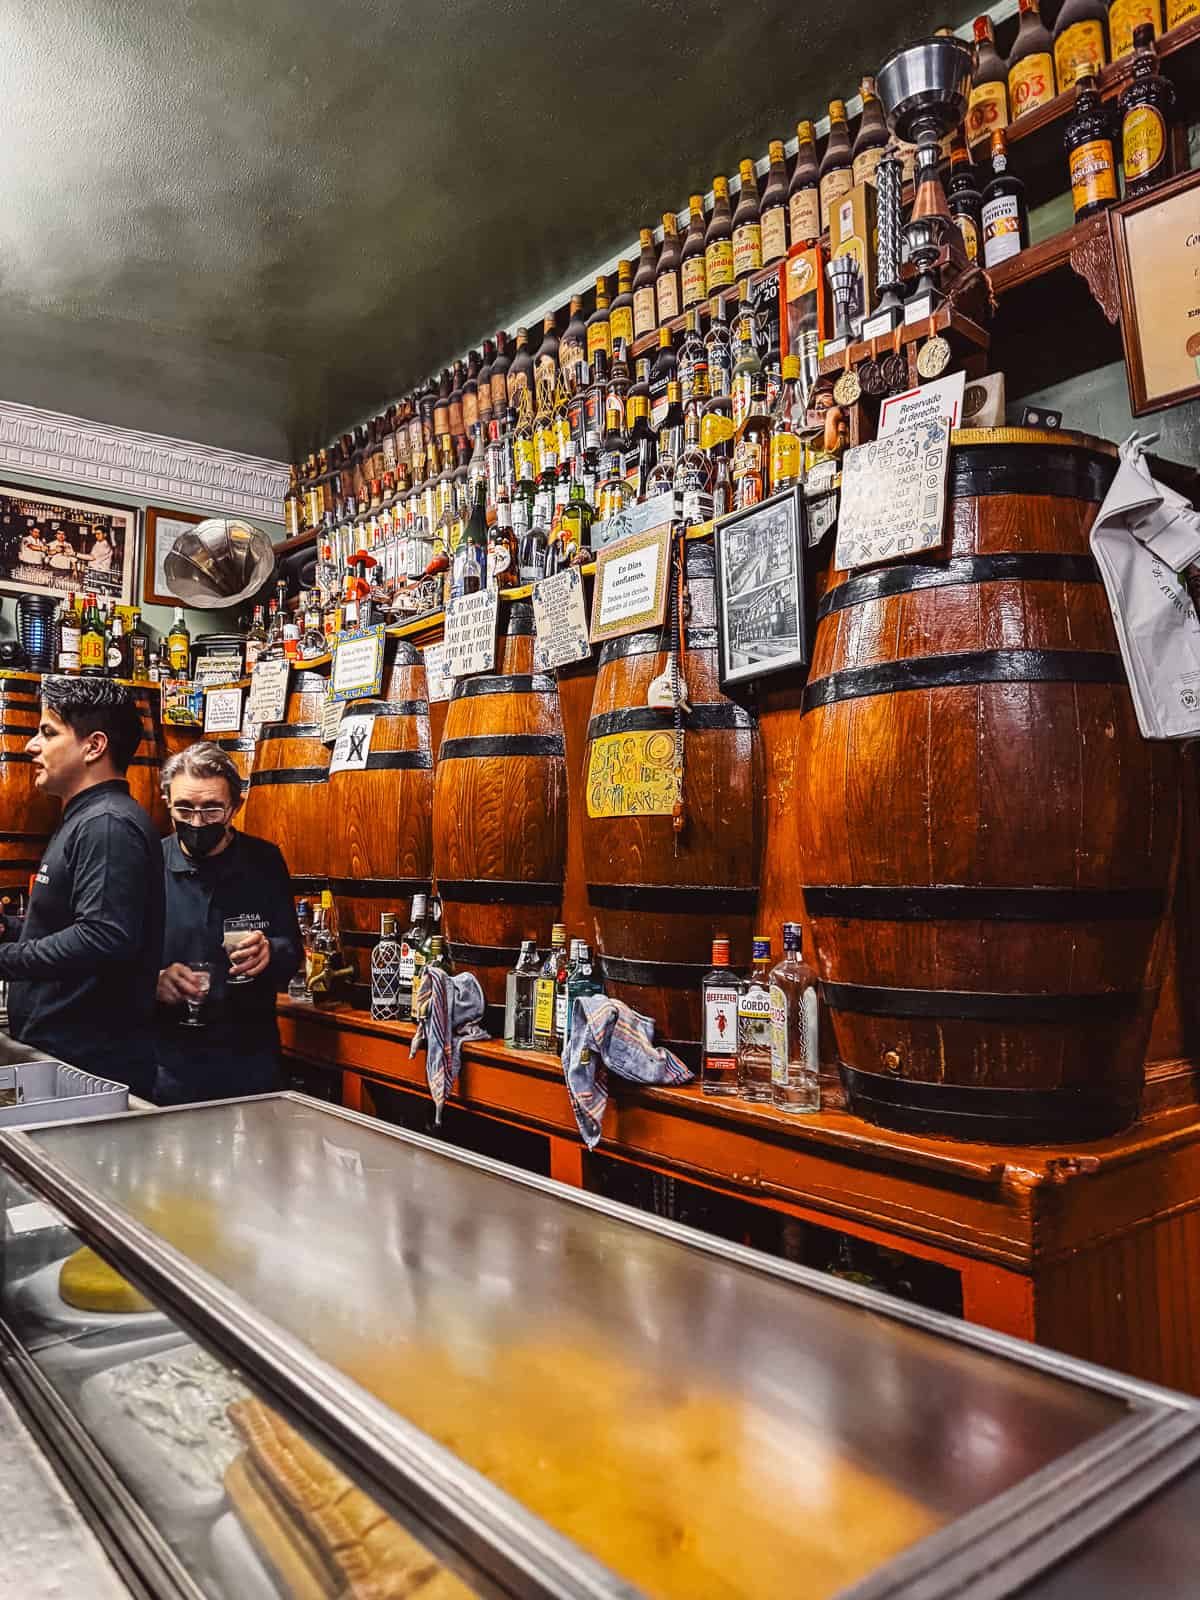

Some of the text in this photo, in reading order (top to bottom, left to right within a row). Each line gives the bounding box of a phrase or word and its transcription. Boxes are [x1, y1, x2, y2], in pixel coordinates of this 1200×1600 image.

[900, 393, 942, 413] Reservado
[618, 561, 642, 575] En Dios
[706, 993, 737, 1003] BEEFEATER
